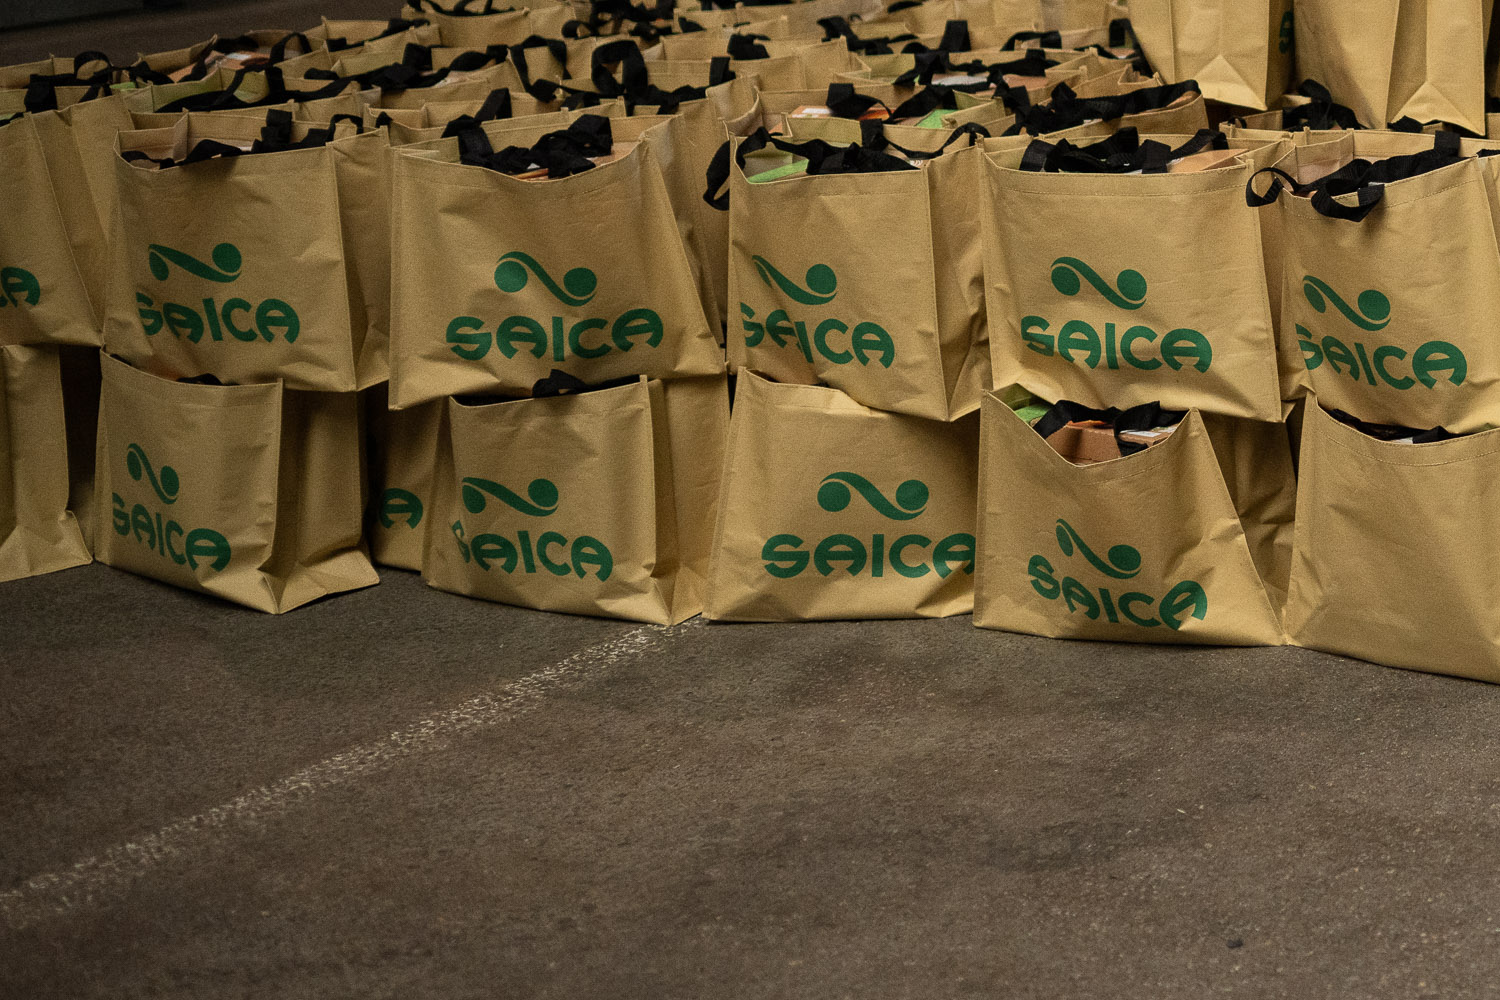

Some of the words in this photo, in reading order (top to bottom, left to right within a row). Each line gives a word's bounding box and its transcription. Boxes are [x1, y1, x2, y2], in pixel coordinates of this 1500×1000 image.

[137, 290, 301, 343] SAICA
[446, 307, 664, 362] SAICA
[740, 301, 896, 370] SAICA
[1021, 315, 1213, 374] SAICA
[1294, 322, 1468, 391] SAICA
[112, 491, 232, 573] SAICA
[761, 533, 975, 580] SAICA
[1027, 553, 1209, 631] SAICA
